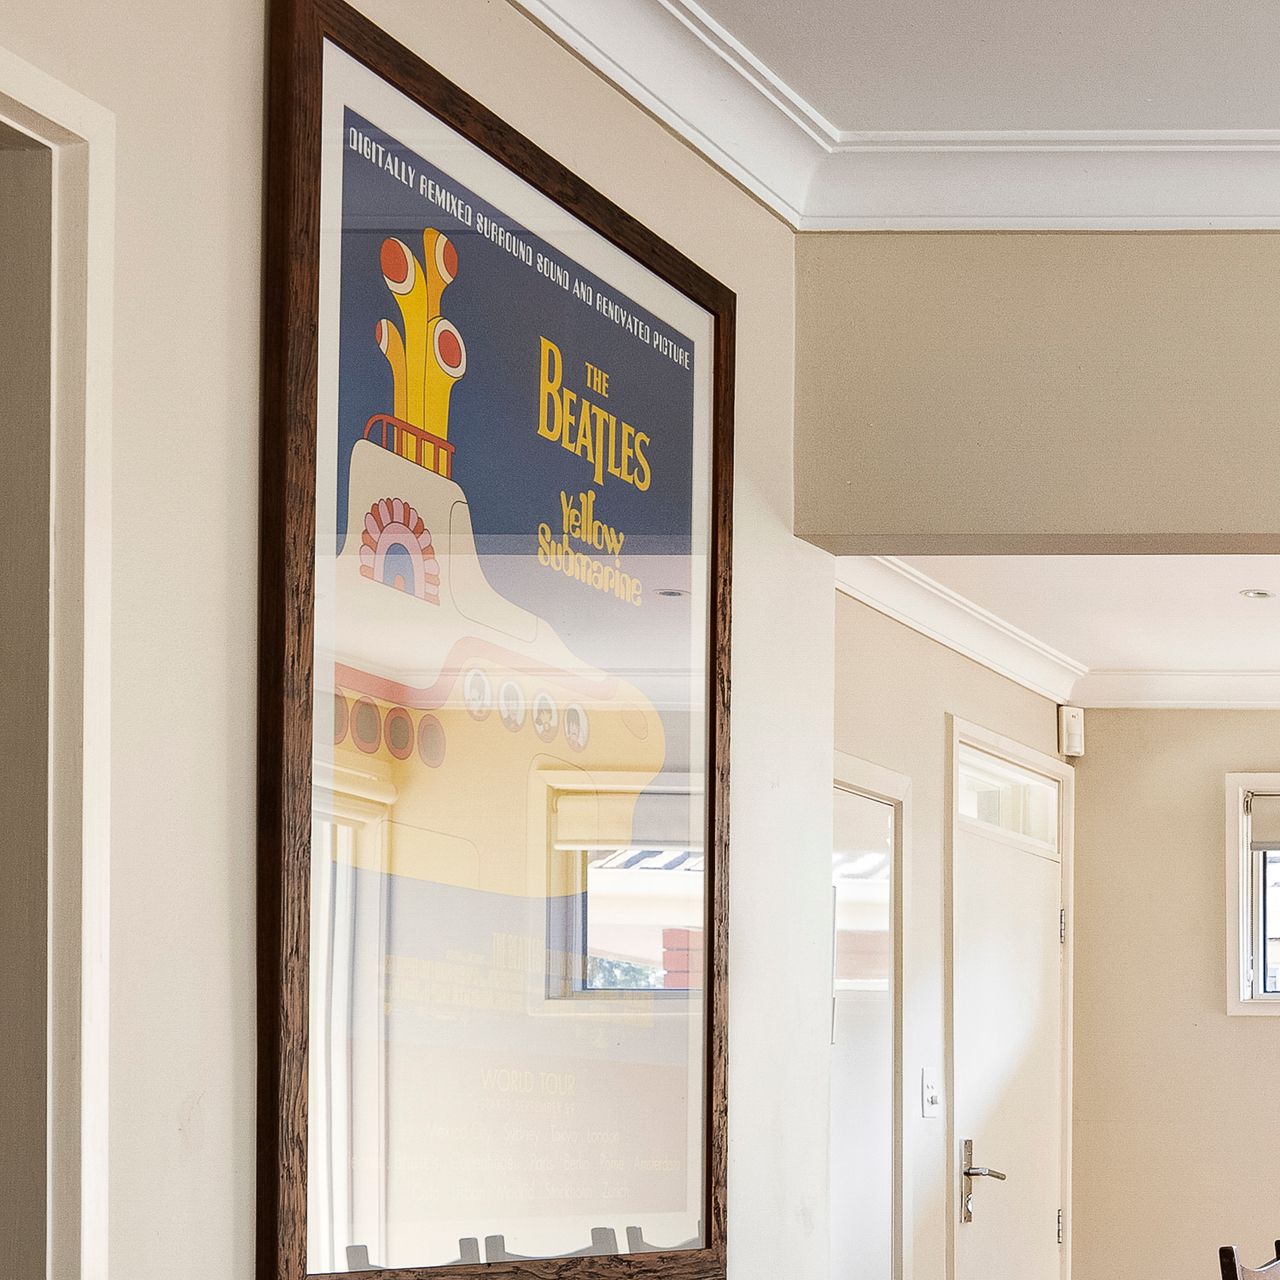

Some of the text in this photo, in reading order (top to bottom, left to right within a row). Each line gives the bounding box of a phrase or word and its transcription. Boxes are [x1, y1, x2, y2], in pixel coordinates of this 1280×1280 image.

[349, 127, 690, 371] DIGITALLY REMIXED SURROUND SOUND AND RENOVATED PICTURE
[537, 335, 652, 492] BEATLES
[585, 361, 609, 398] THE
[560, 489, 625, 558] Yellow
[537, 522, 643, 607] Submarine
[481, 1068, 576, 1098] WORLD TOUR
